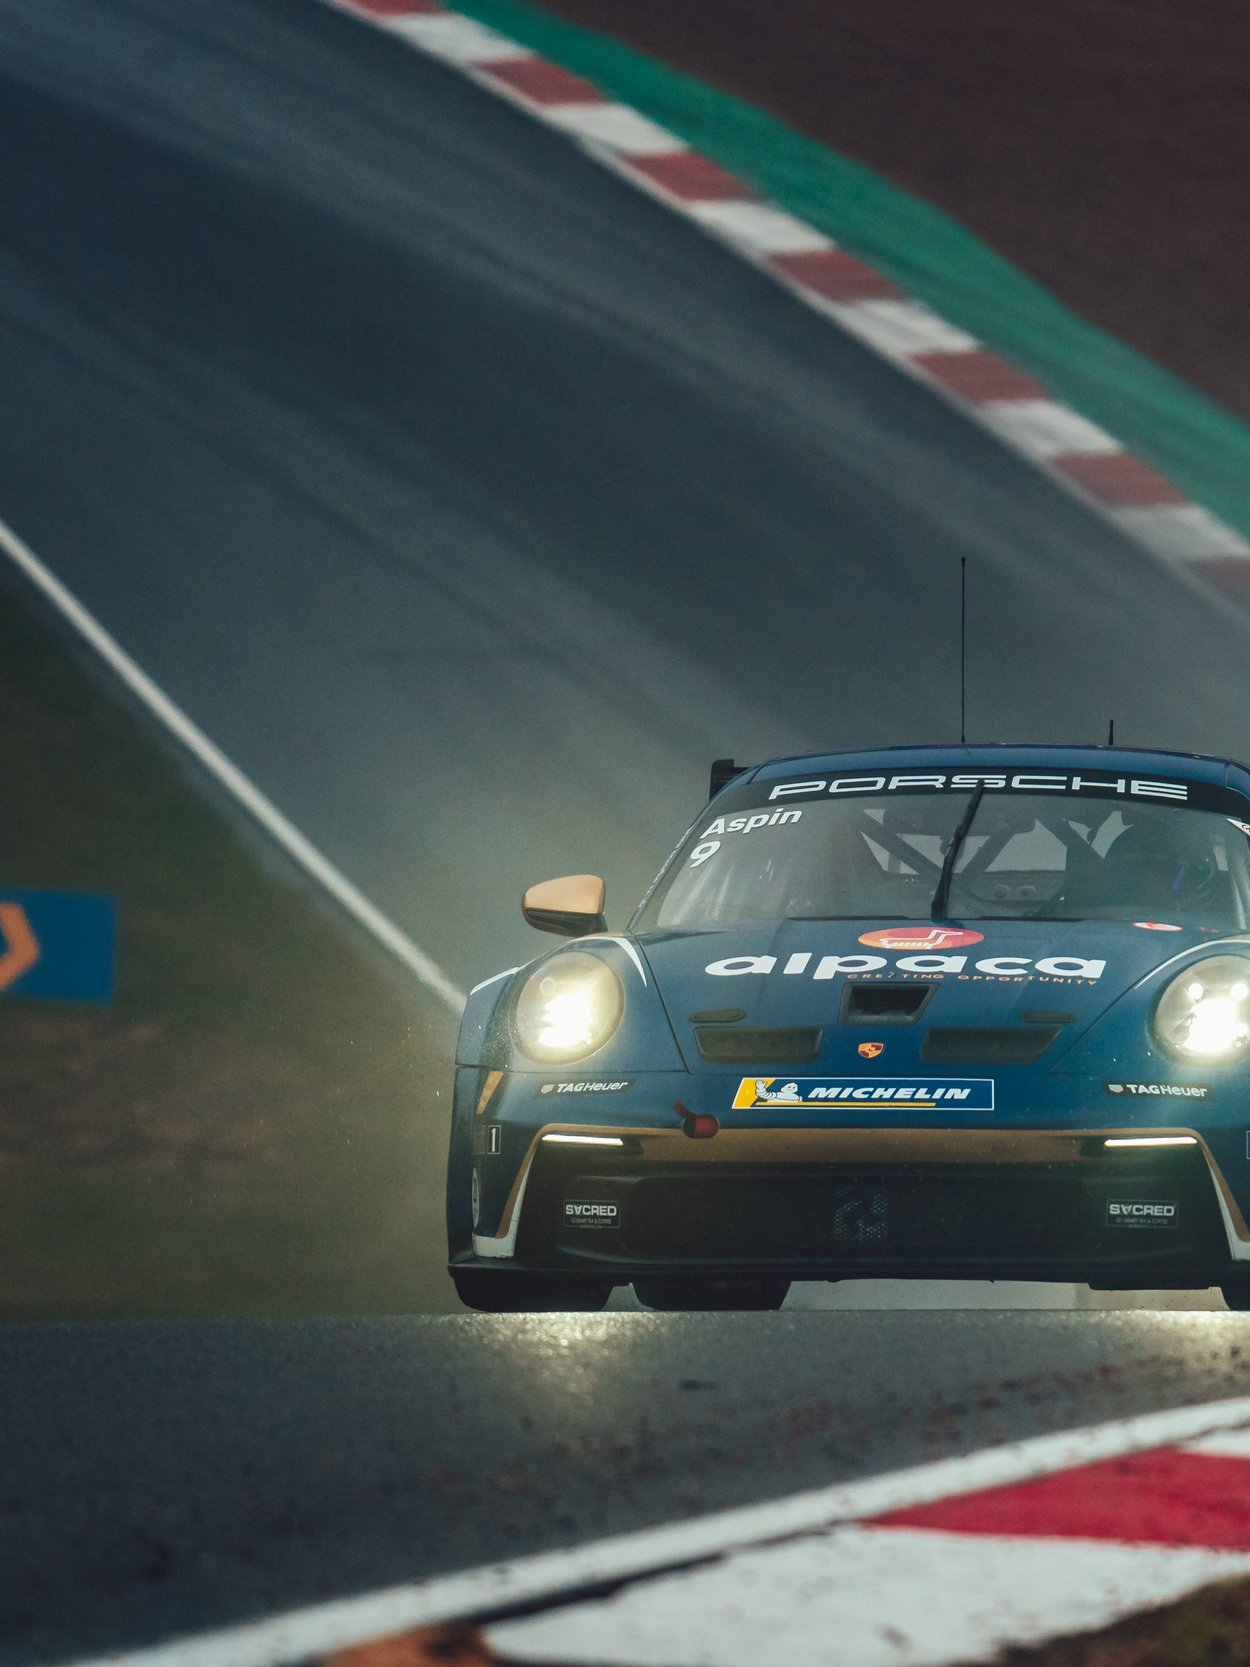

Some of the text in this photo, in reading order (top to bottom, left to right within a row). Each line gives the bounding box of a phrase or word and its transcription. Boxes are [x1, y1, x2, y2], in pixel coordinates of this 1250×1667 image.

[768, 775, 1188, 800] PORSCHE
[699, 808, 802, 840] Aspin
[689, 840, 721, 868] 9
[704, 952, 1107, 980] alpaca
[957, 975, 1099, 985] OPPORTUNITY
[807, 1087, 971, 1100] MICHELIN
[565, 1204, 617, 1216] SACRED
[1109, 1203, 1175, 1217] SACRED
